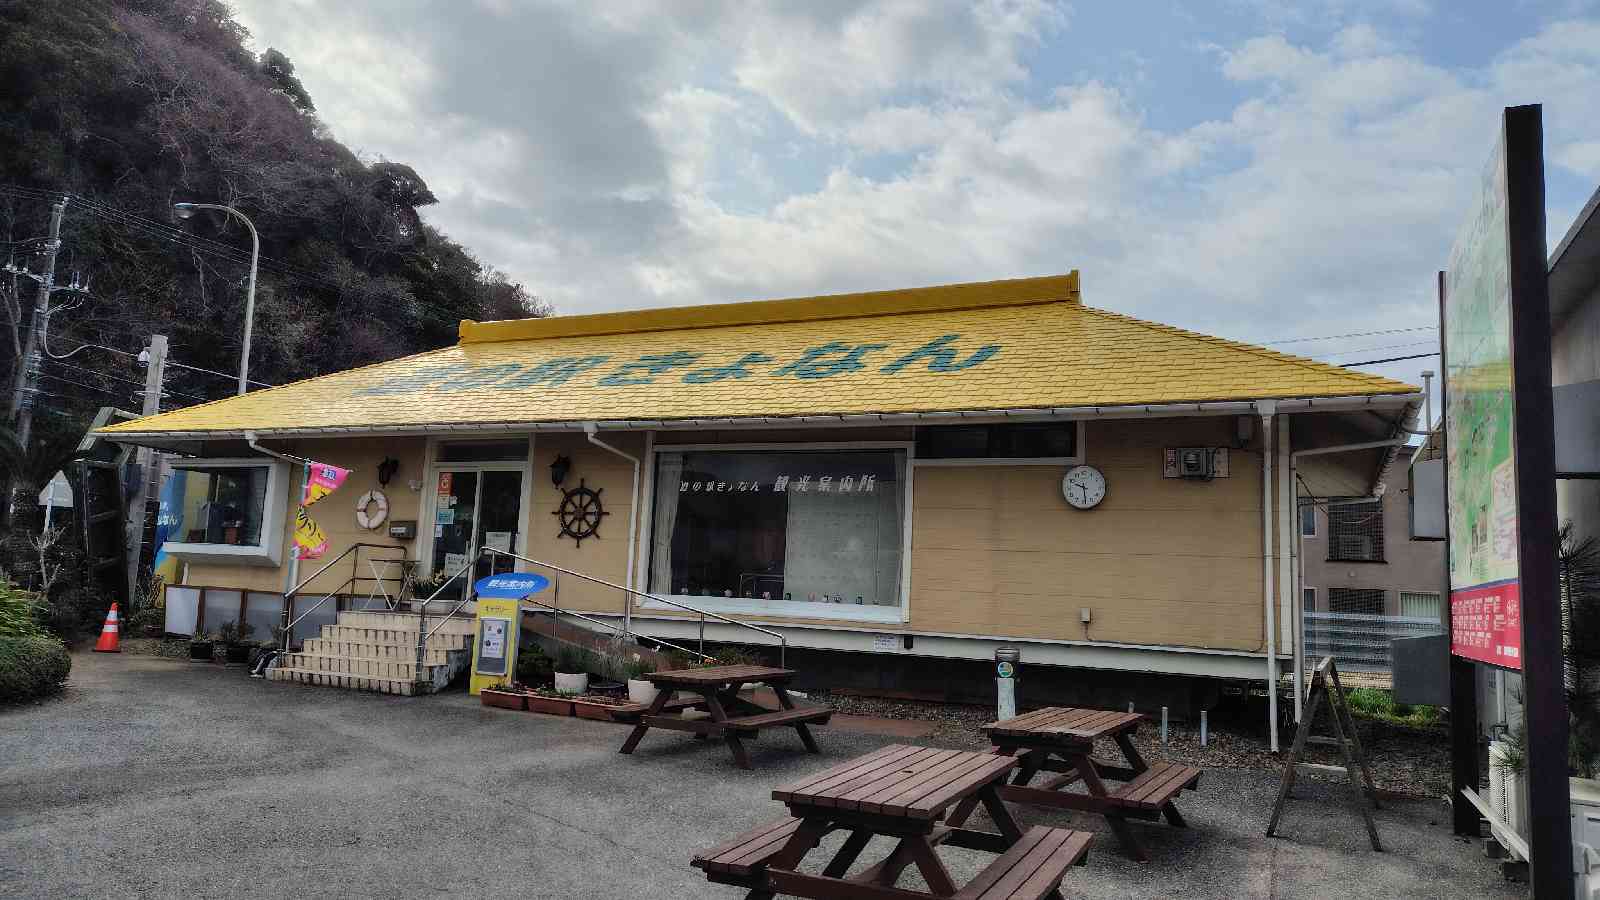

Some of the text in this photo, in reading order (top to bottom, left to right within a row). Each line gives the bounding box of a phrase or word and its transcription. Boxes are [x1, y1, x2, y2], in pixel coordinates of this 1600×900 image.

[773, 474, 876, 492] 観光案内所
